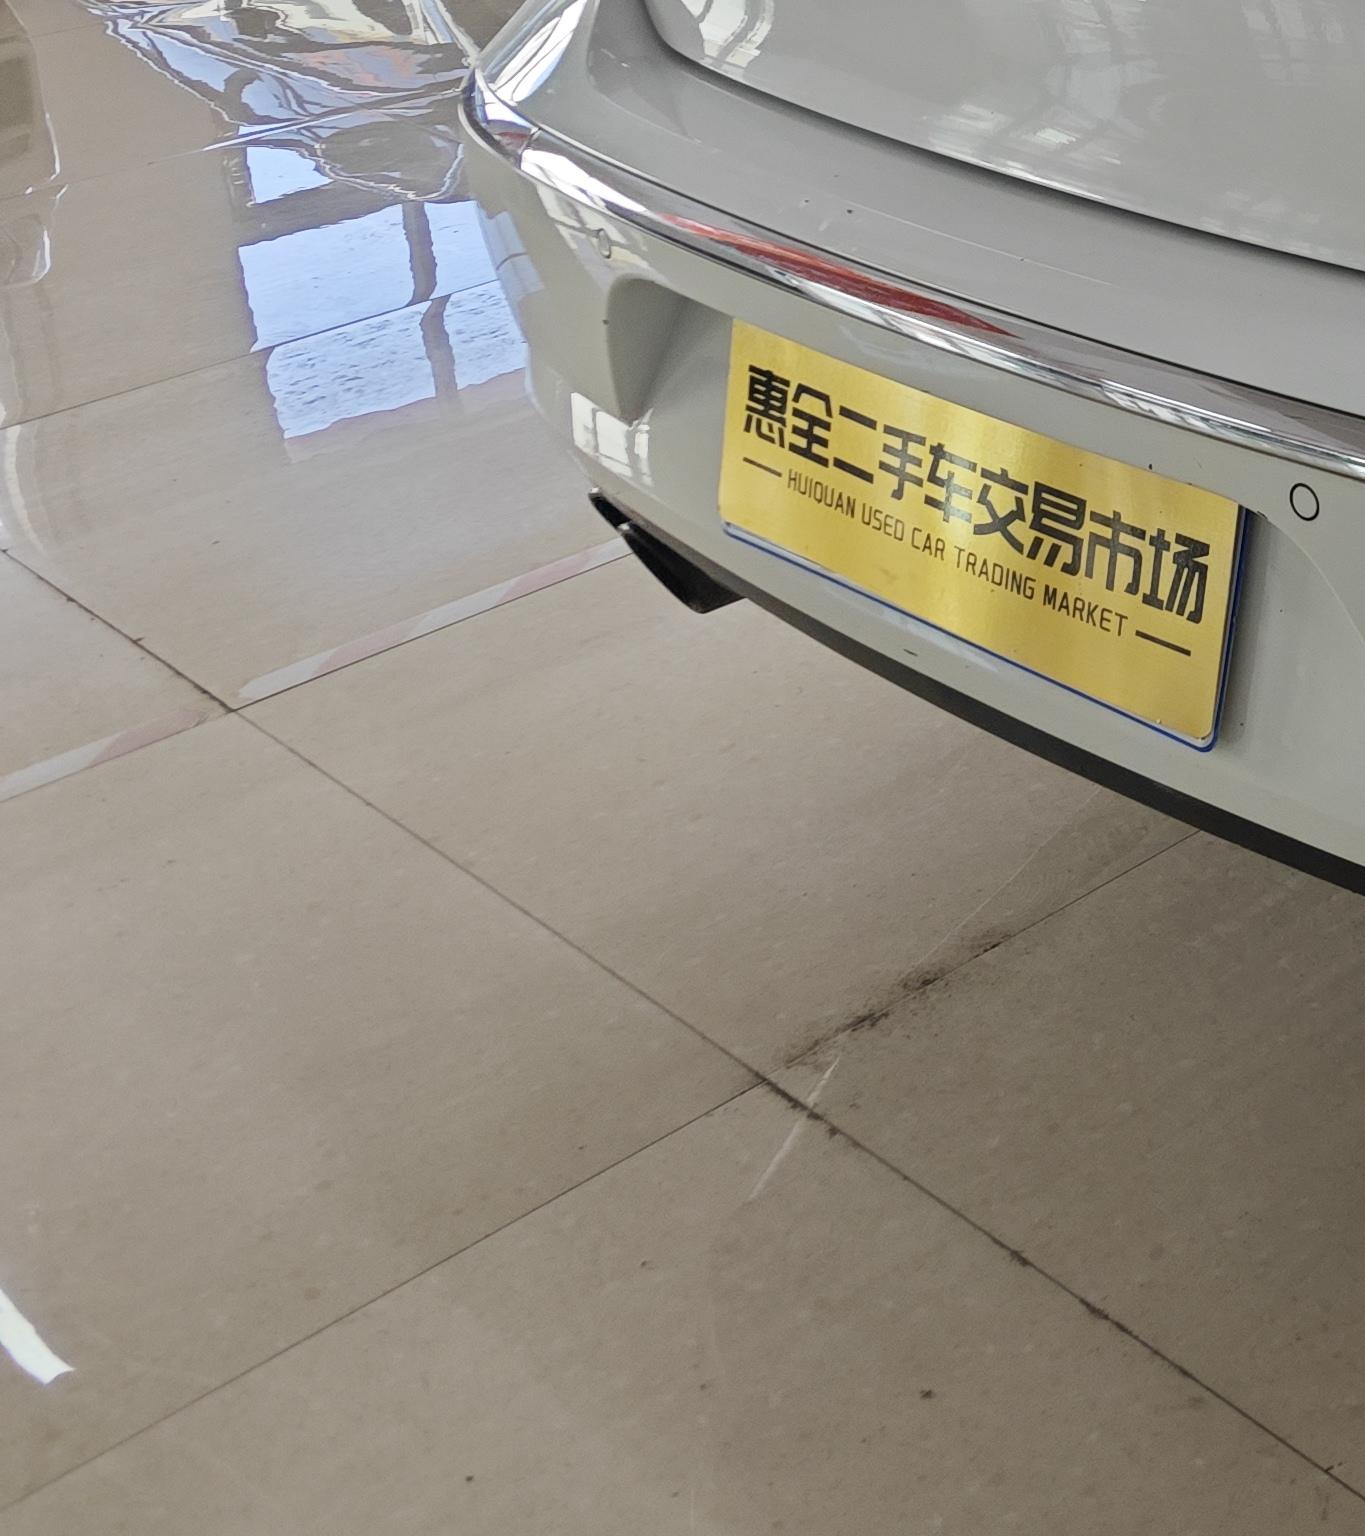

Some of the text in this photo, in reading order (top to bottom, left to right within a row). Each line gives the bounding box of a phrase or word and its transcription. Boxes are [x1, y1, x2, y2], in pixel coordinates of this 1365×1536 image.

[744, 364, 1211, 625] 惠全二手车交易市场
[787, 468, 1129, 639] HUIQUAN USED CAR TRADING MARKET
